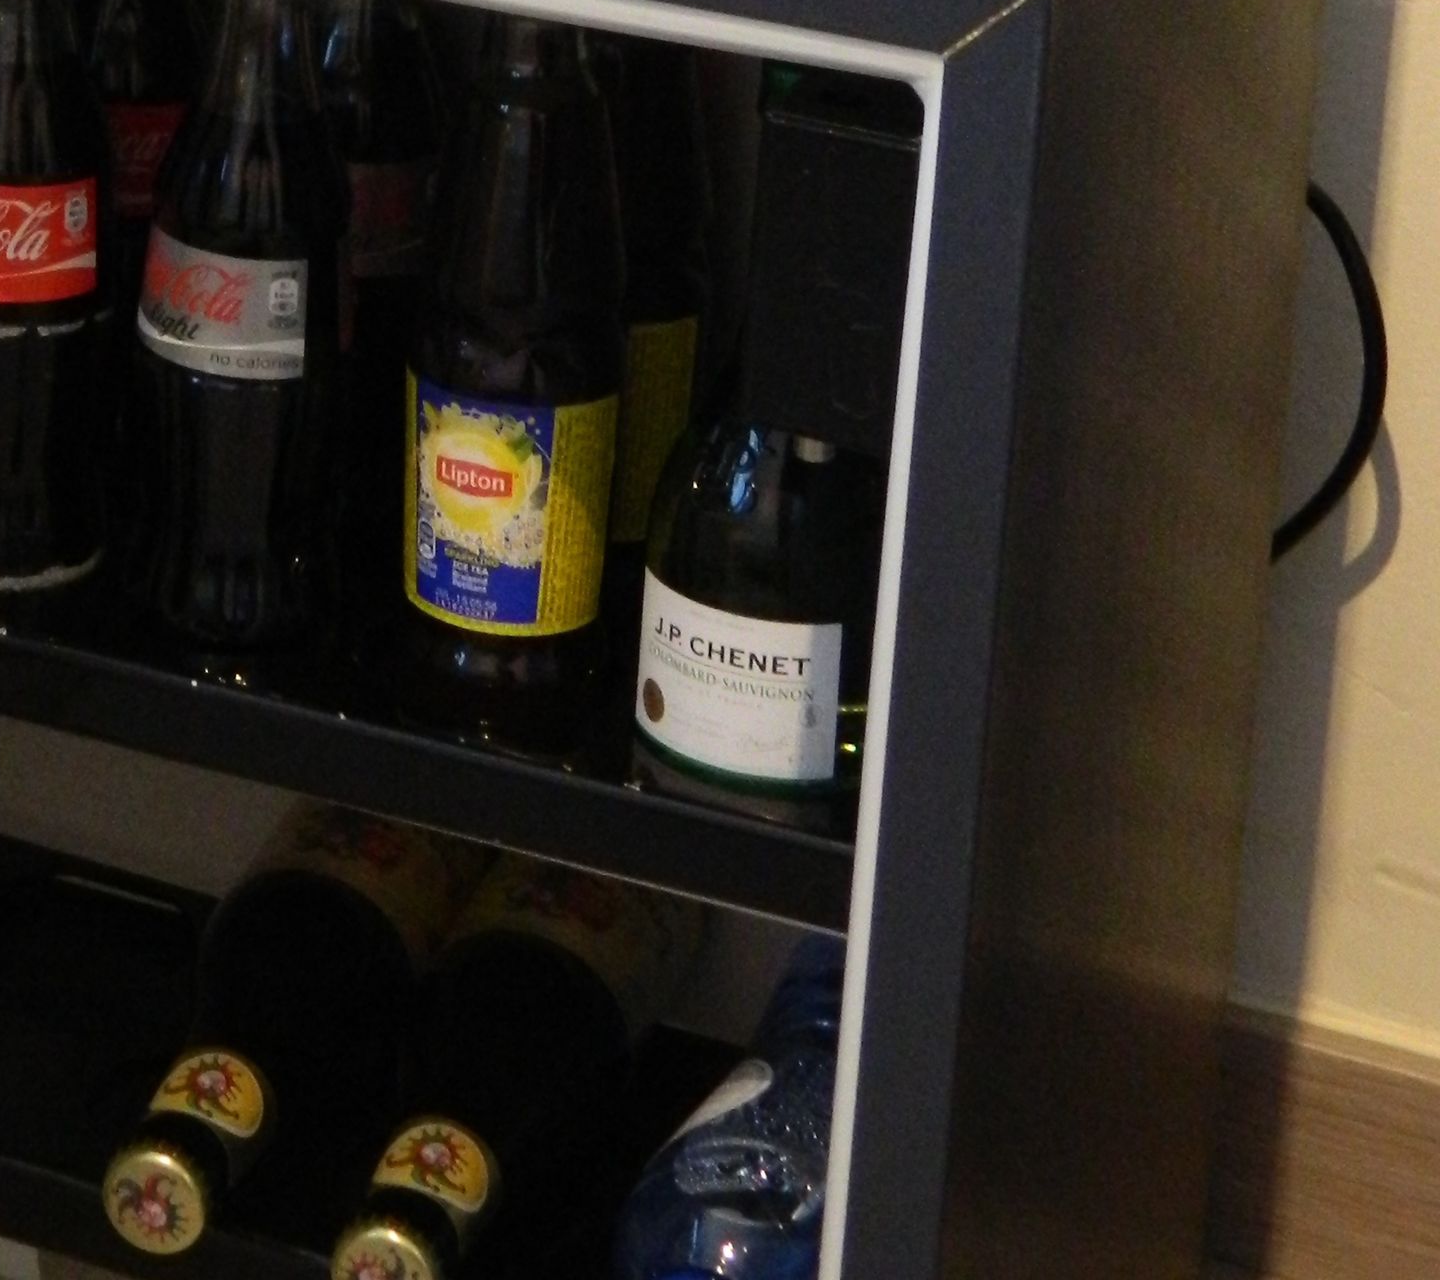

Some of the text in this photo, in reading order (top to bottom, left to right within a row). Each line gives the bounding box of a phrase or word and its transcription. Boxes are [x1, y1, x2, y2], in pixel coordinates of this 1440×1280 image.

[209, 351, 231, 366] no
[440, 461, 507, 493] Lipton
[654, 616, 683, 646] J.P.
[689, 634, 811, 677] CHENET
